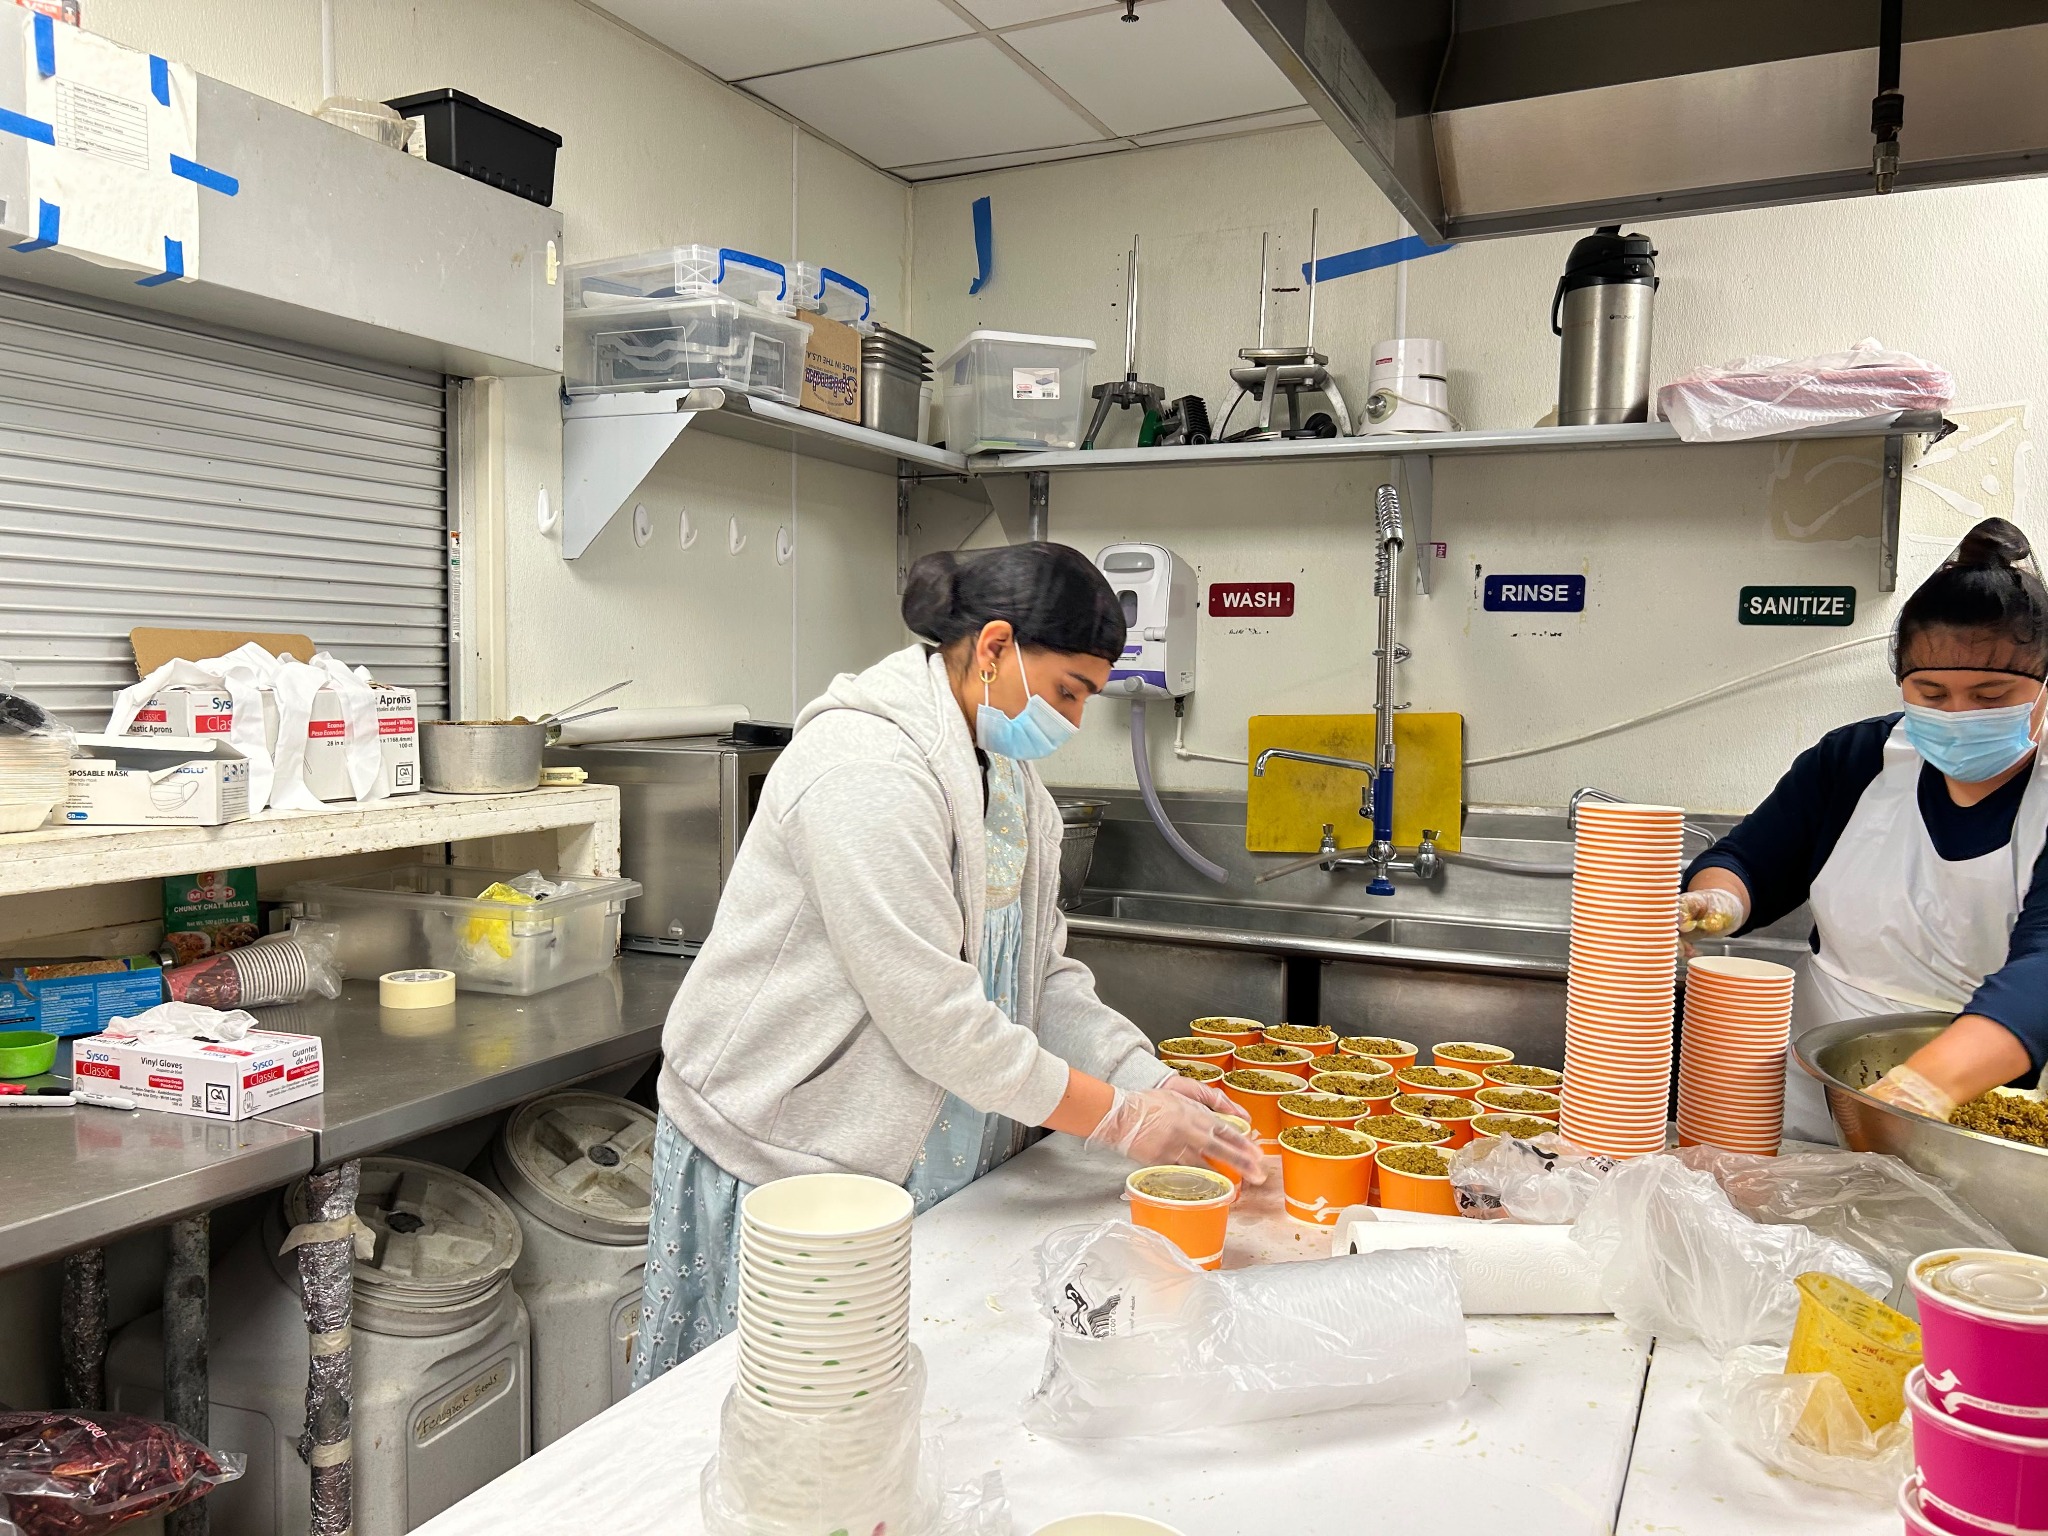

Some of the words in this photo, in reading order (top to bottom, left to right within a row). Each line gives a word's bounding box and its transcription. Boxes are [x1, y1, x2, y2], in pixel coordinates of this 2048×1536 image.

[822, 356, 834, 367] THE
[834, 360, 842, 369] IN
[842, 363, 858, 375] MADE
[1222, 591, 1281, 608] WASH
[1501, 584, 1569, 602] RINSE
[1749, 596, 1845, 615] SANITIZE
[379, 695, 411, 706] Aprons
[138, 710, 162, 721] Classic
[149, 725, 173, 735] Aprons
[173, 904, 202, 913] CHUNKY
[203, 902, 221, 910] CHAT
[222, 900, 250, 908] MASALA
[86, 1049, 109, 1062] Sysco
[292, 1045, 318, 1058] Guantes
[141, 1057, 158, 1069] Vinyl
[159, 1059, 183, 1070] Gloves
[252, 1059, 274, 1071] Sysco
[296, 1057, 303, 1066] de
[304, 1052, 319, 1063] Vinil
[82, 1063, 113, 1078] Classic
[250, 1070, 278, 1086] Classic
[1861, 1344, 1880, 1355] PINT
